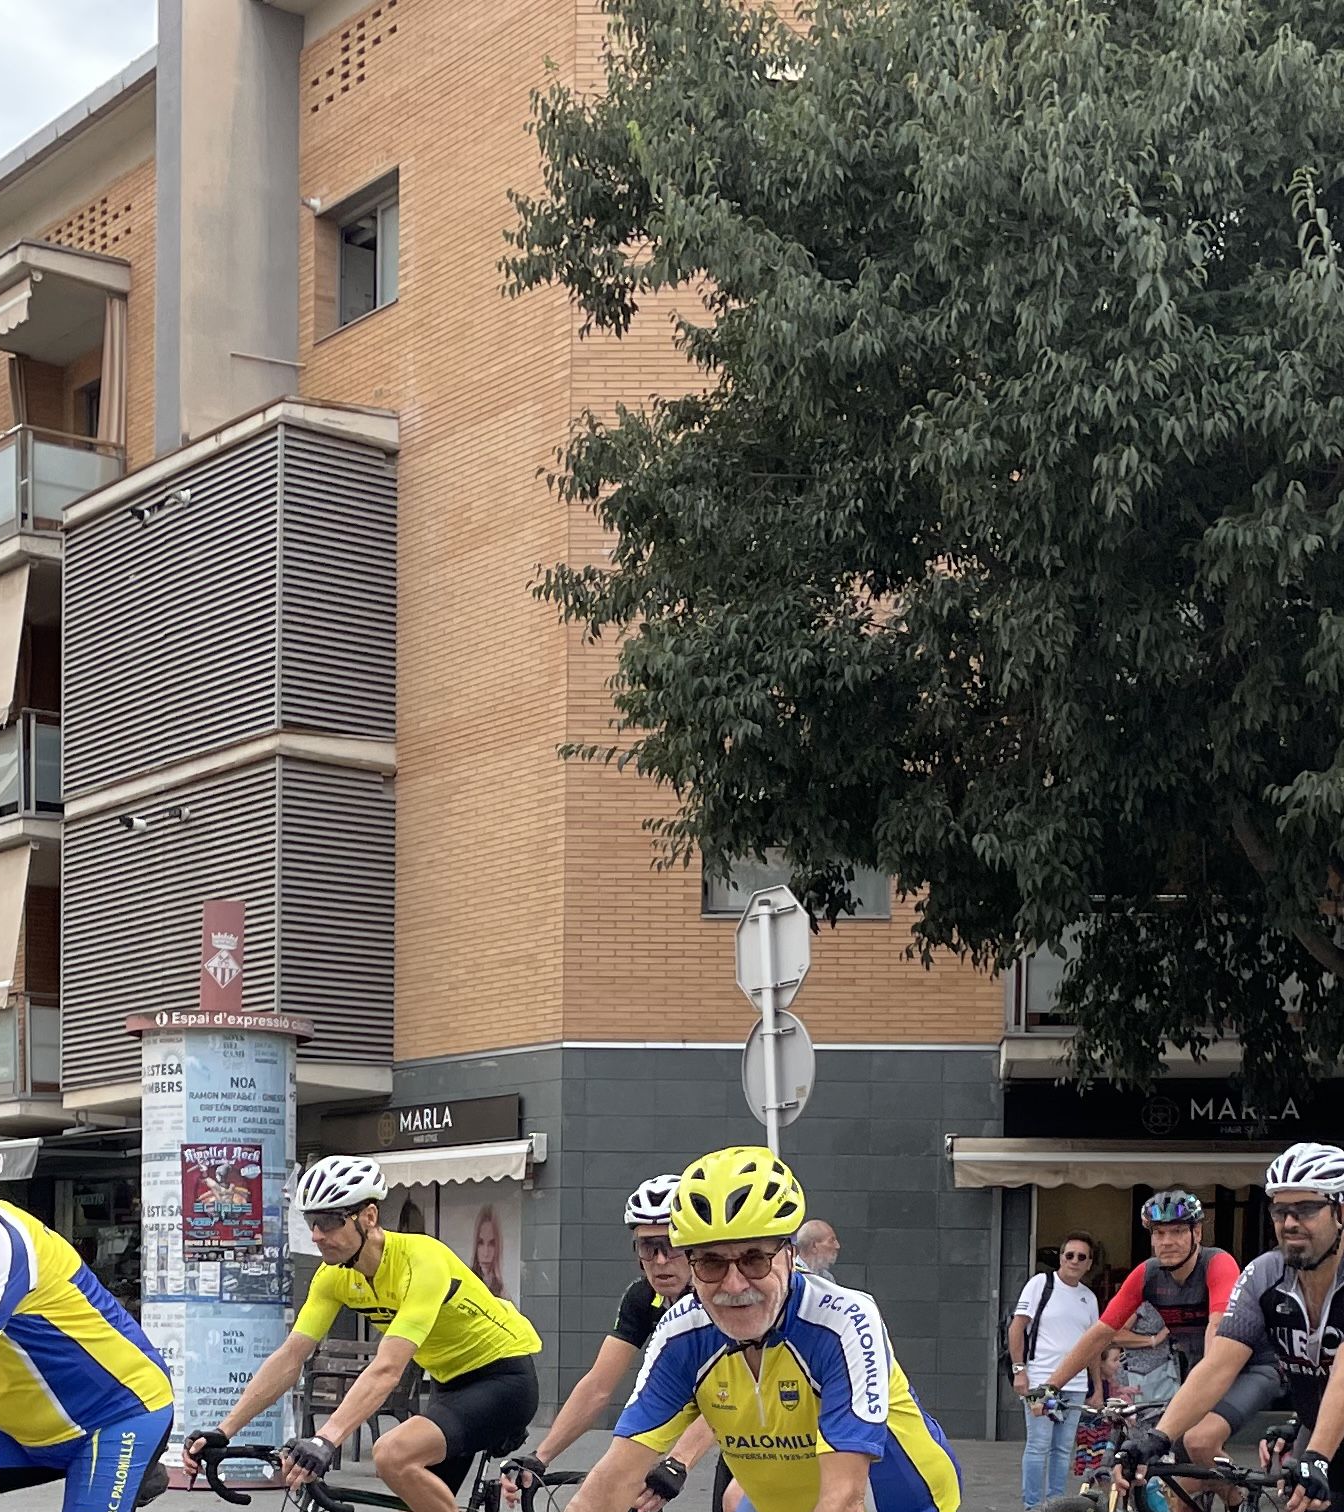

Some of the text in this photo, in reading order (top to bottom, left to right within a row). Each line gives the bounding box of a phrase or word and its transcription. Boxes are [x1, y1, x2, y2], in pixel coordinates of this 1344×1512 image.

[171, 1012, 210, 1026] Espai
[230, 1077, 257, 1089] NOA
[1190, 1097, 1301, 1120] MARA
[399, 1105, 453, 1133] MARLA
[844, 1302, 882, 1416] PALOMILLAS
[229, 1372, 254, 1383] NOA
[725, 1433, 817, 1449] PALOMILL
